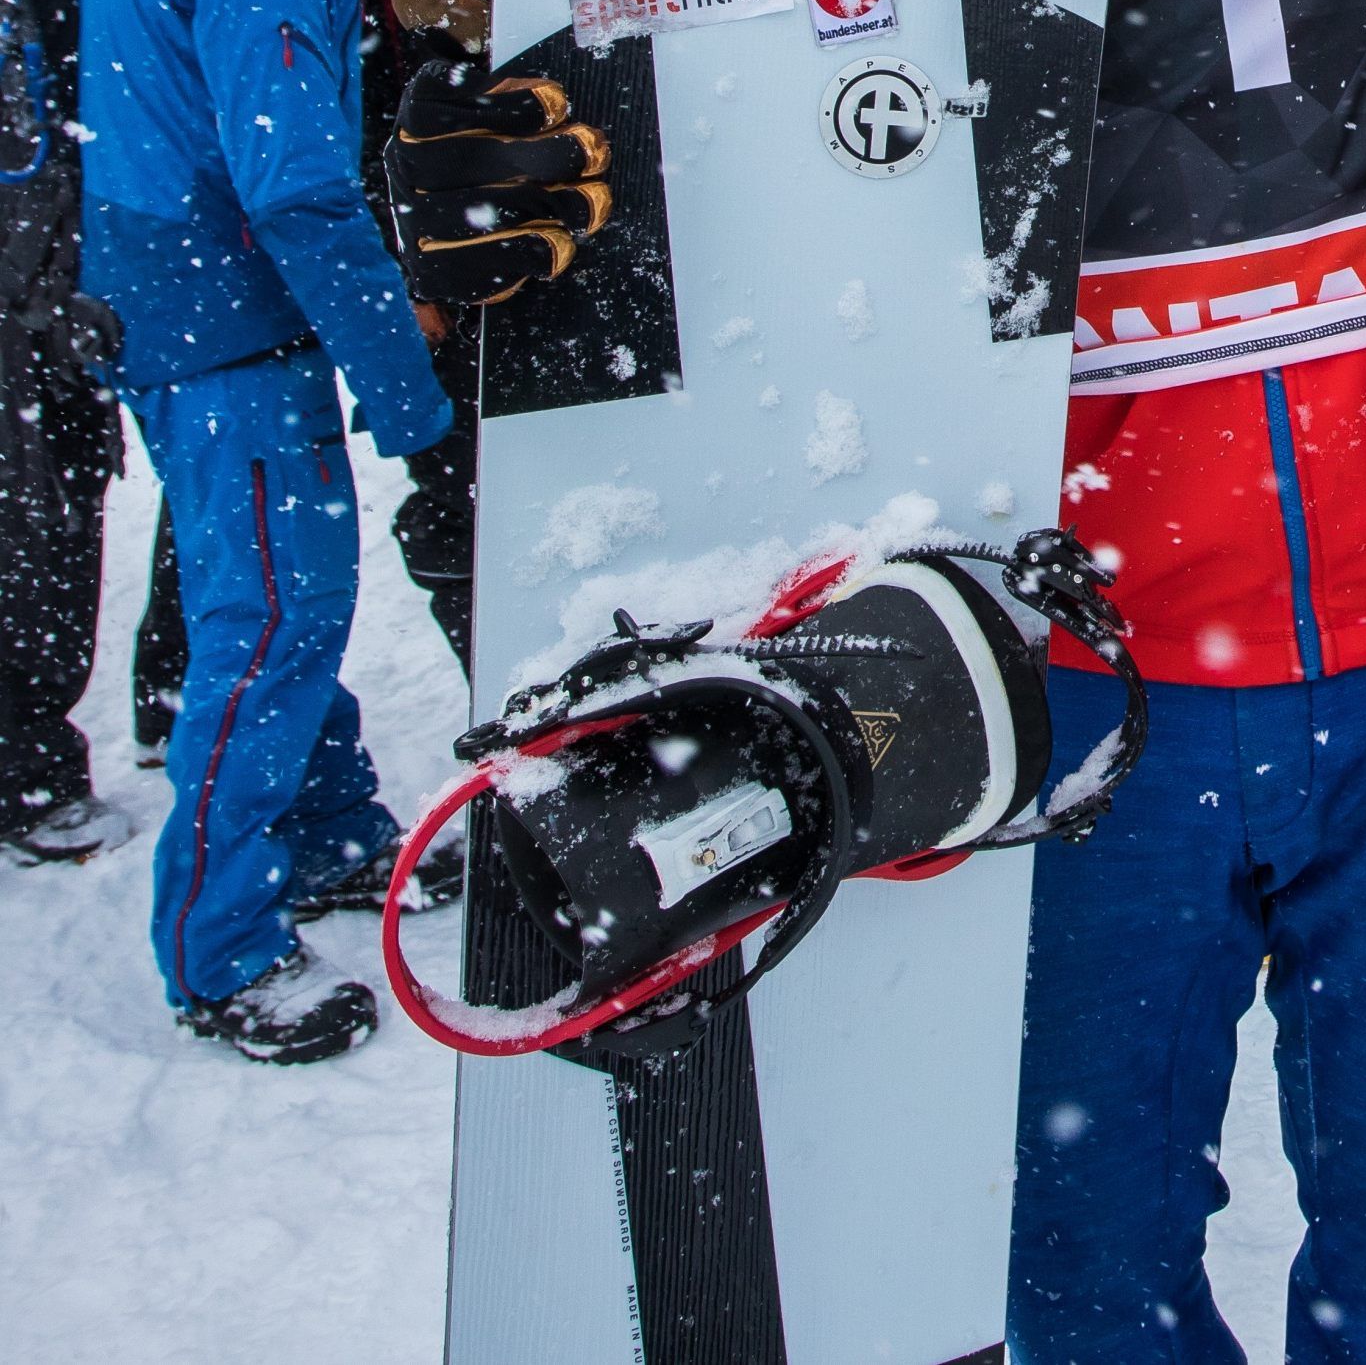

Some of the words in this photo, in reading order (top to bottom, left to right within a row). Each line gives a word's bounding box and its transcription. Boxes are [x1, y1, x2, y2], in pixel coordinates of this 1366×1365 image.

[817, 15, 894, 42] bundesheer.at
[838, 60, 932, 94] APEX
[829, 139, 925, 174] CSTM
[603, 1078, 616, 1113] APEX
[607, 1118, 620, 1154] CSTM
[613, 1160, 631, 1254] SNOWBOARDS
[626, 1285, 639, 1322] MADE
[631, 1327, 641, 1341] IN
